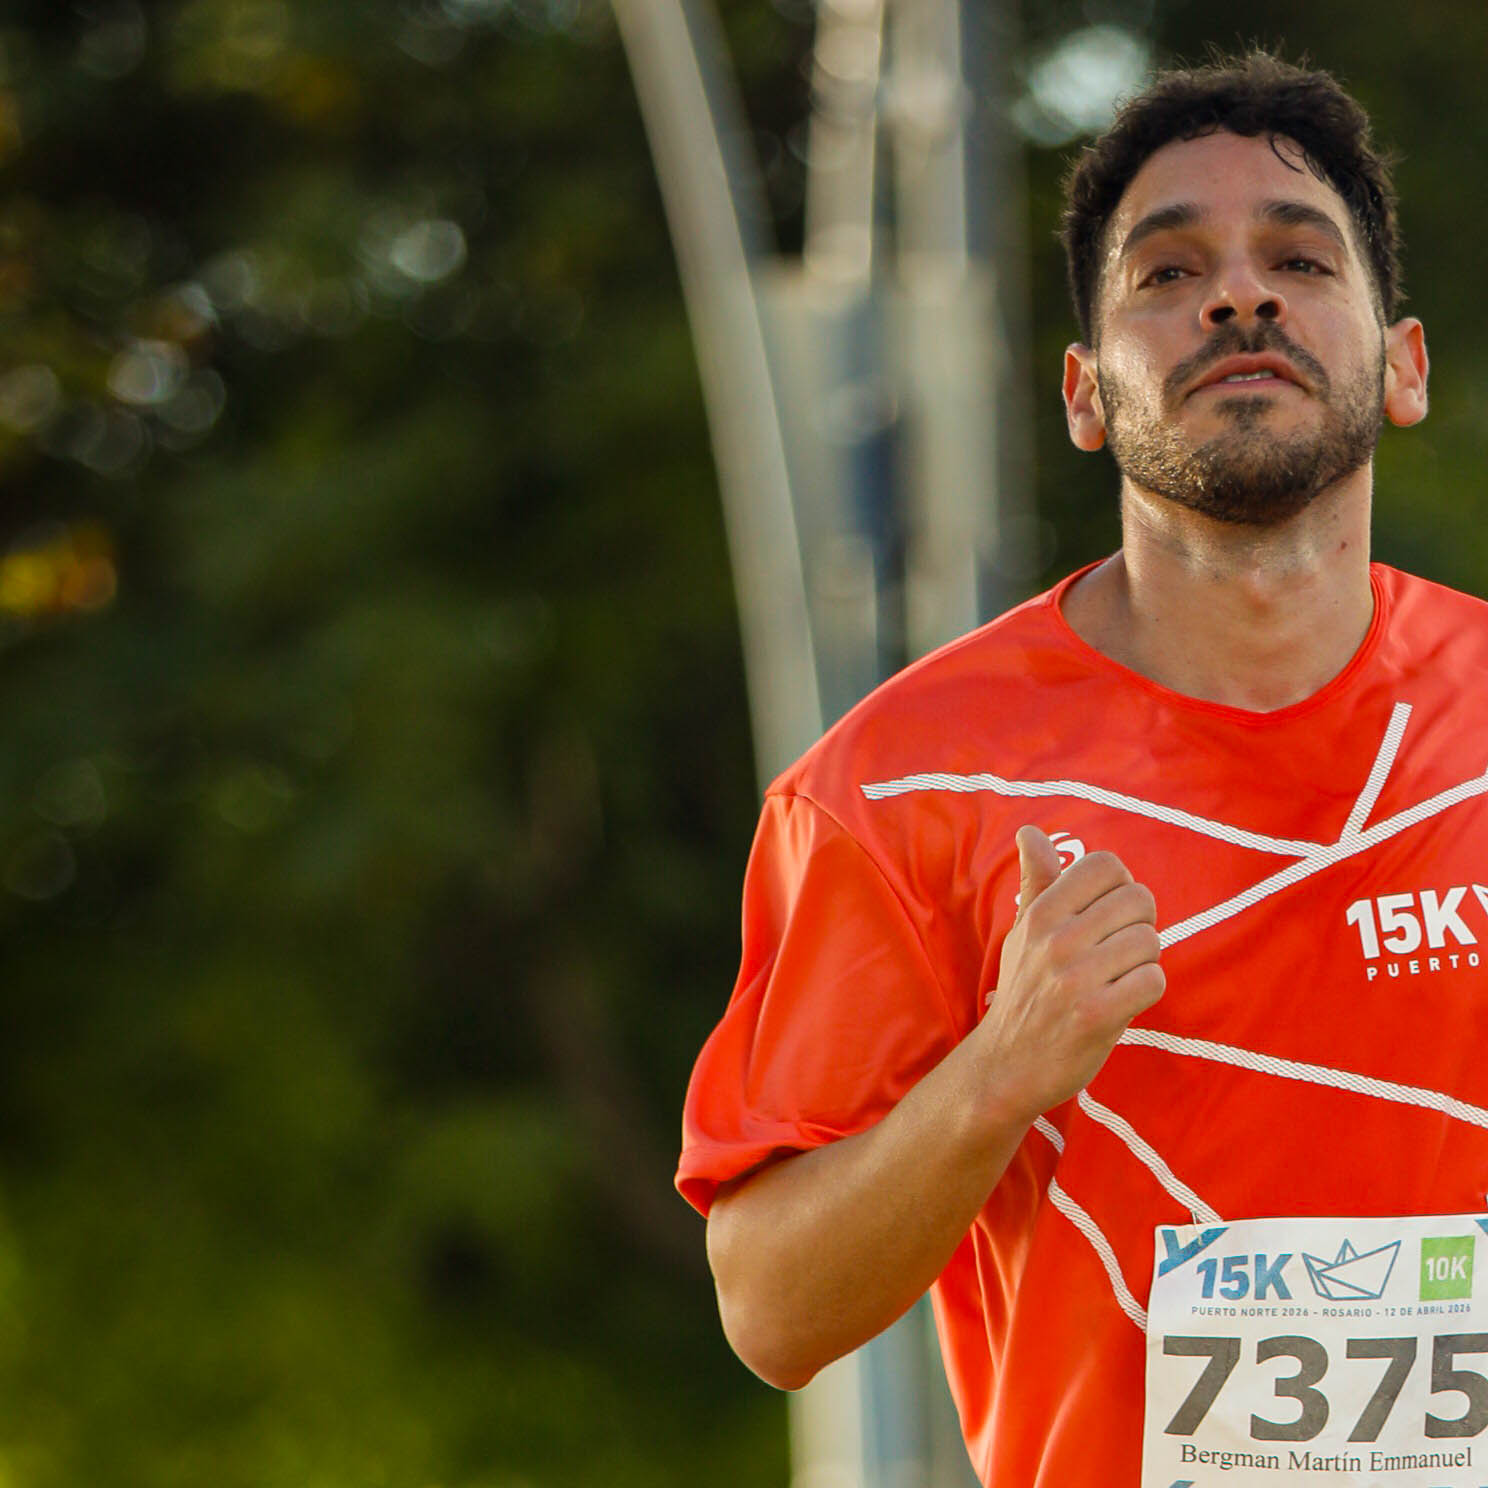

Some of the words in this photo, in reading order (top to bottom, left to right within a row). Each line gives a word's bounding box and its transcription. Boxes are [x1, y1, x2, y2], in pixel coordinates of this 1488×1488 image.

[1346, 886, 1478, 960] 15K
[1366, 951, 1480, 981] PUERTO
[1196, 1253, 1294, 1301] 15K
[1425, 1255, 1468, 1281] 10K
[1191, 1306, 1236, 1317] PUERTO
[1241, 1307, 1278, 1317] NORTE
[1282, 1307, 1309, 1317] 2026
[1322, 1308, 1372, 1318] ROSARIO
[1384, 1307, 1396, 1317] 12
[1400, 1306, 1413, 1316] DE
[1416, 1304, 1445, 1315] ABRIL
[1448, 1303, 1471, 1313] 2026
[1180, 1443, 1280, 1471] Bergman
[1288, 1450, 1361, 1472] Martín
[1369, 1446, 1472, 1472] Emmanuel
